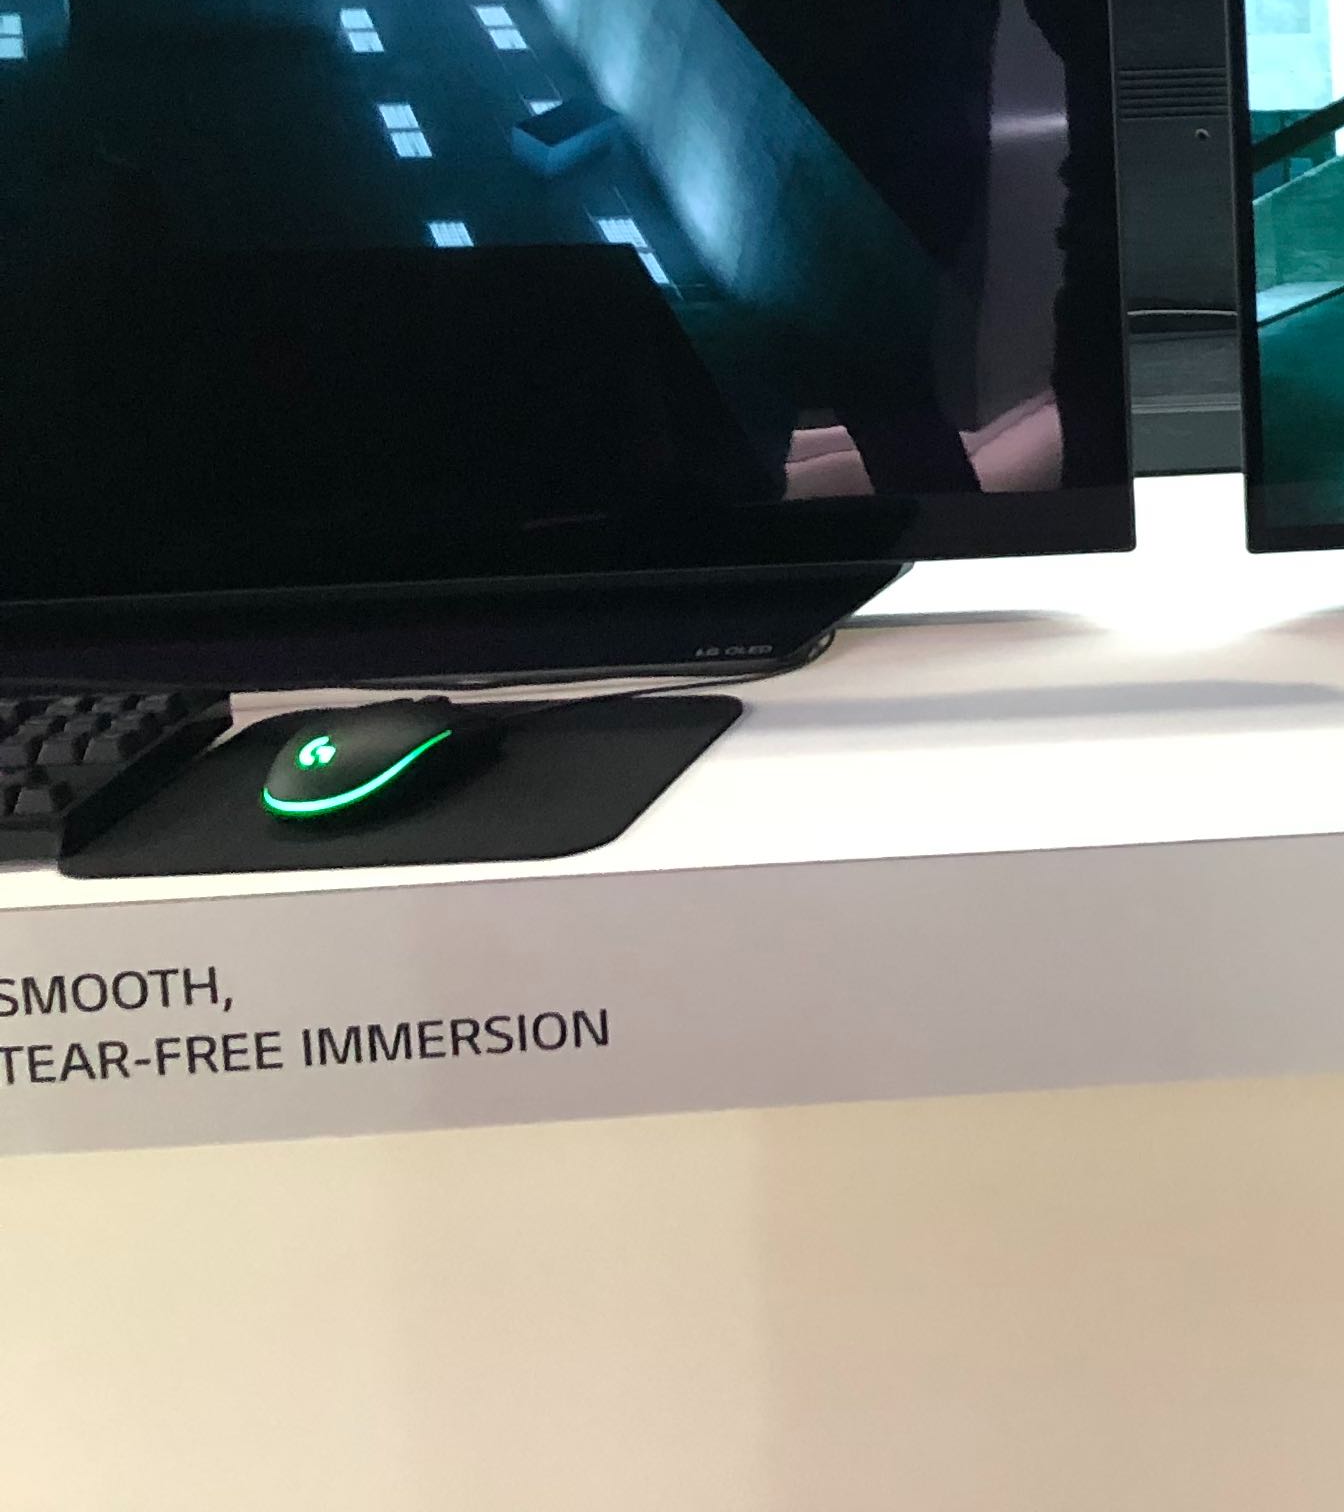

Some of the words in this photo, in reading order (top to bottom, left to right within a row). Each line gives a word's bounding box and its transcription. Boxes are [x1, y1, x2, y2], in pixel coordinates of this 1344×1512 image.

[0, 965, 234, 1018] SMOOTH,
[0, 1030, 285, 1086] TEAR-FREE
[302, 1007, 611, 1067] IMMERSION
